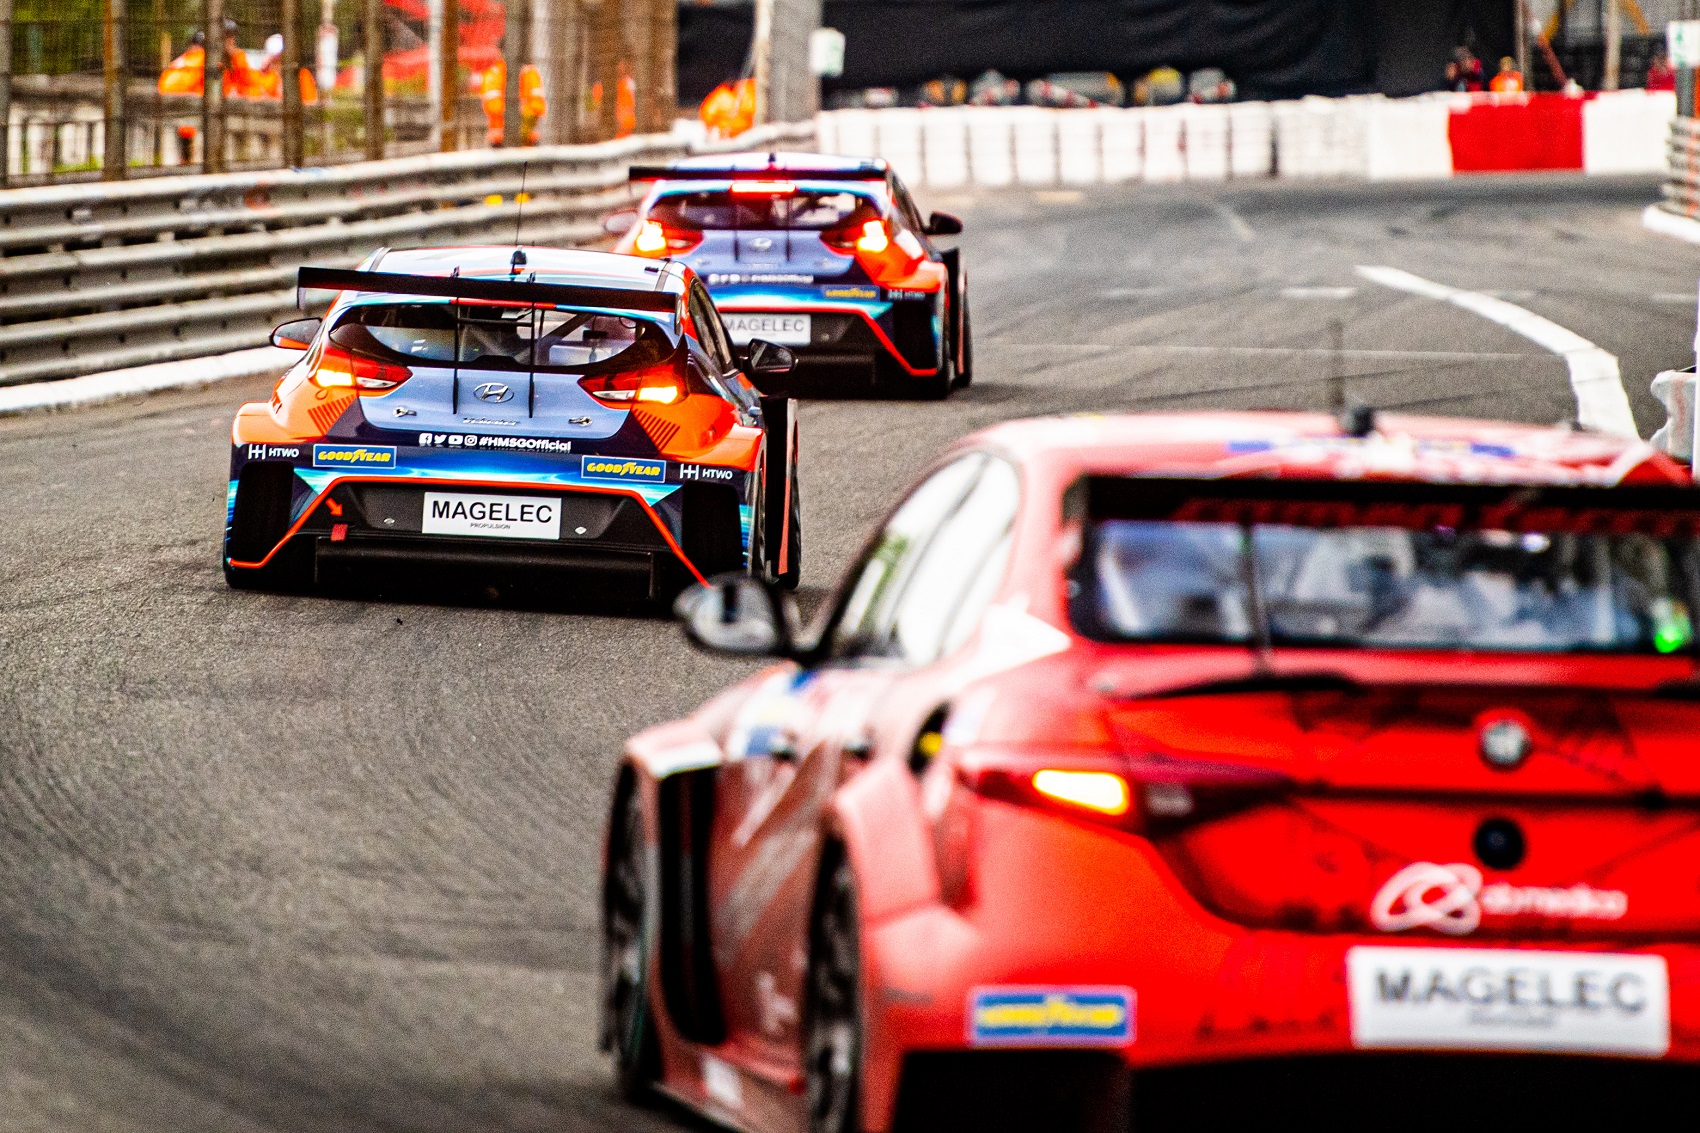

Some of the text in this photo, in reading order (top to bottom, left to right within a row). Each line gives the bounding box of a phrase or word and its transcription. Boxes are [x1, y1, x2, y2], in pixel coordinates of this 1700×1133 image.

[479, 436, 571, 451] #HMSGOfficial
[268, 447, 300, 458] HTWO
[317, 448, 392, 464] GOODYEAR
[586, 461, 660, 477] GOODYEAR
[702, 468, 733, 480] HTWO
[432, 500, 552, 524] MAGELEC
[1375, 965, 1646, 1014] MAGELEC
